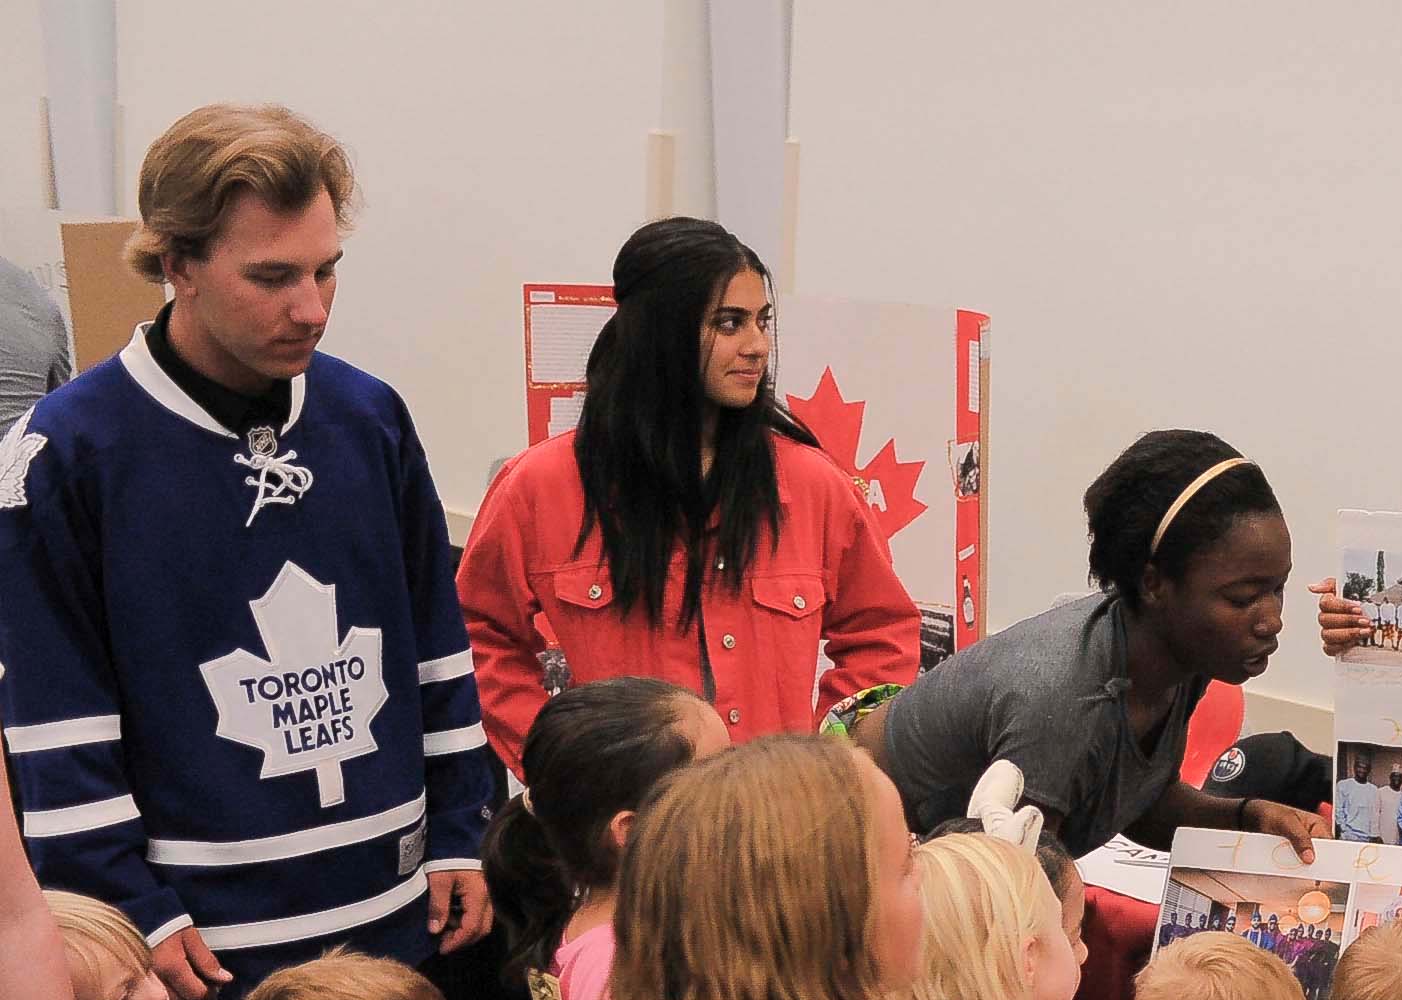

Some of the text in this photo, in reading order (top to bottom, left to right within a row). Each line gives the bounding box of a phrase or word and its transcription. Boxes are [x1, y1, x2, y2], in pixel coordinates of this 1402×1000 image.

[239, 656, 365, 703] TORONTO
[272, 687, 353, 728] MAPLE
[283, 716, 354, 754] LEAFS
